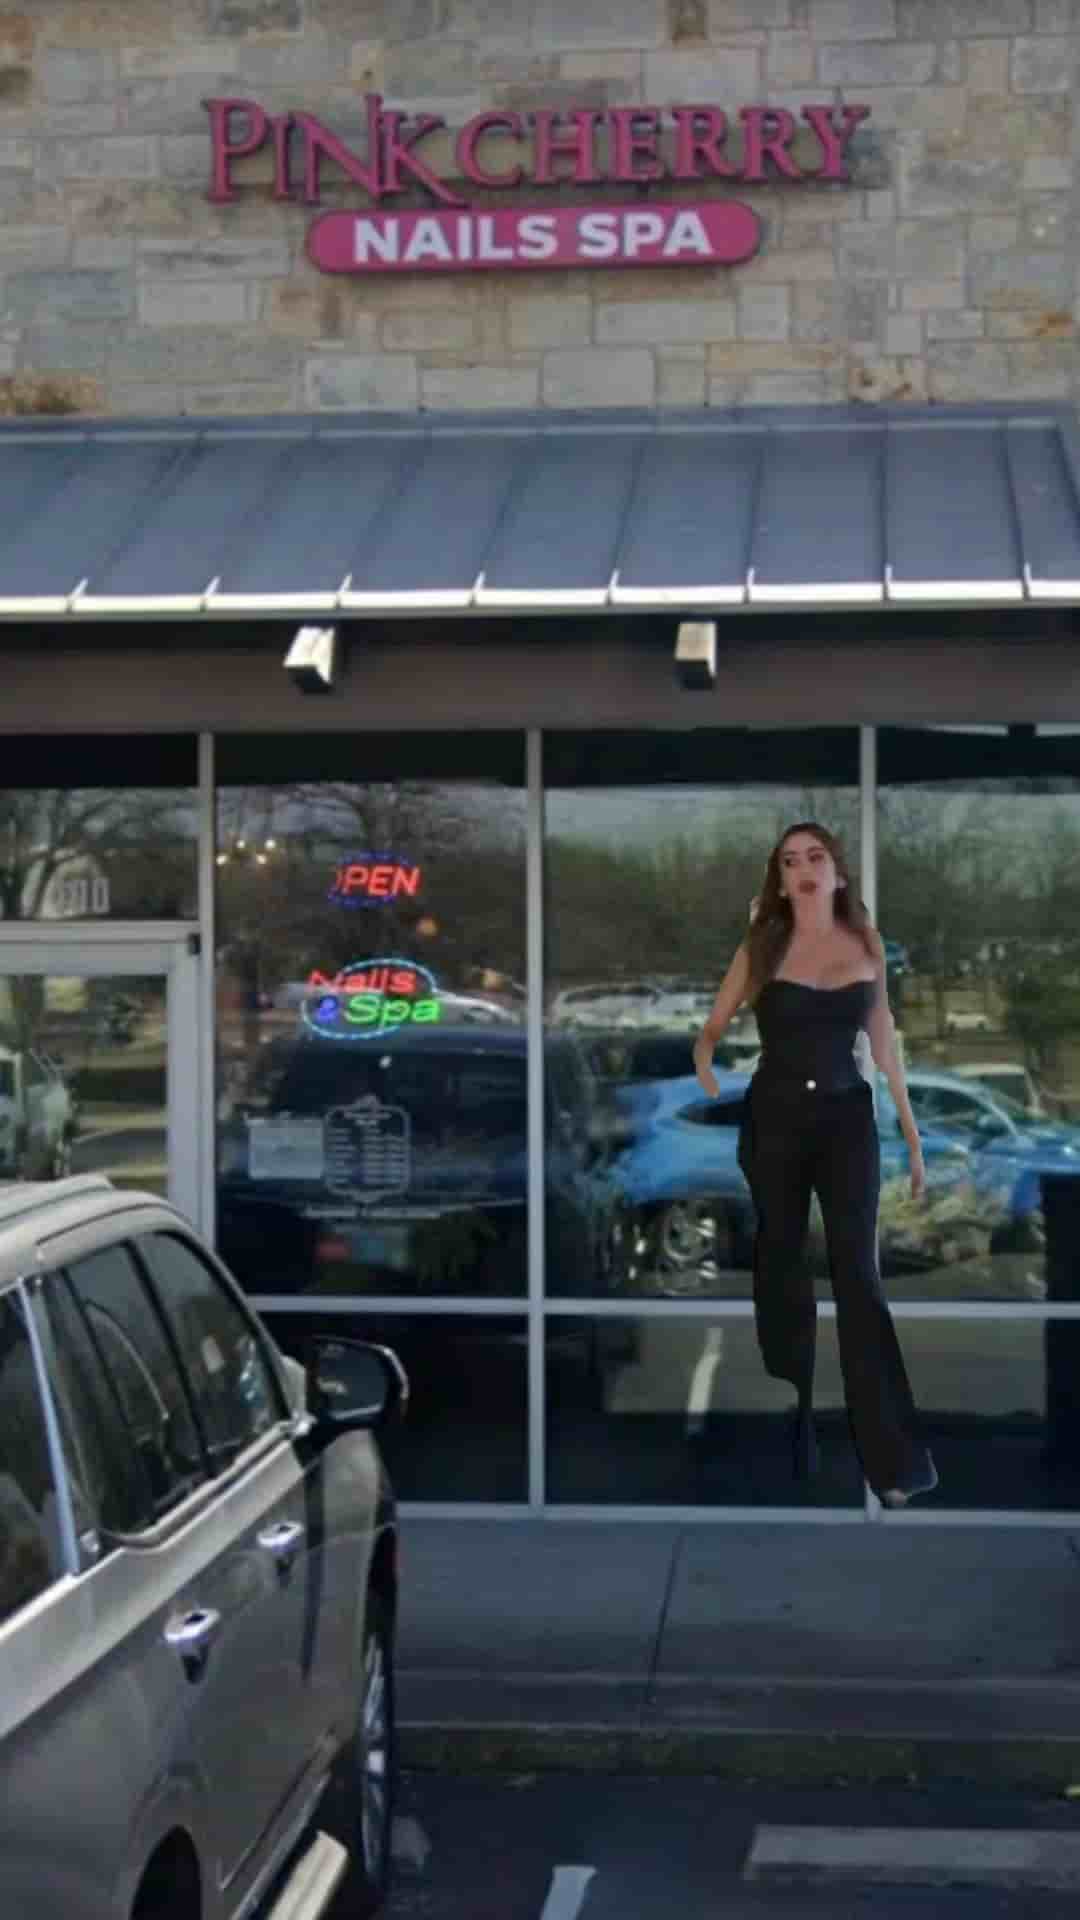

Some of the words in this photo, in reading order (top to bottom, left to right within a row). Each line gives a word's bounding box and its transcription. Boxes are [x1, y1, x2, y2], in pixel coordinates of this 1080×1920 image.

[203, 93, 468, 208] PINK
[456, 105, 871, 187] CHERRY
[353, 216, 558, 264] NAILS
[577, 211, 712, 260] SPA
[307, 967, 416, 993] Nails
[343, 993, 440, 1027] Spa
